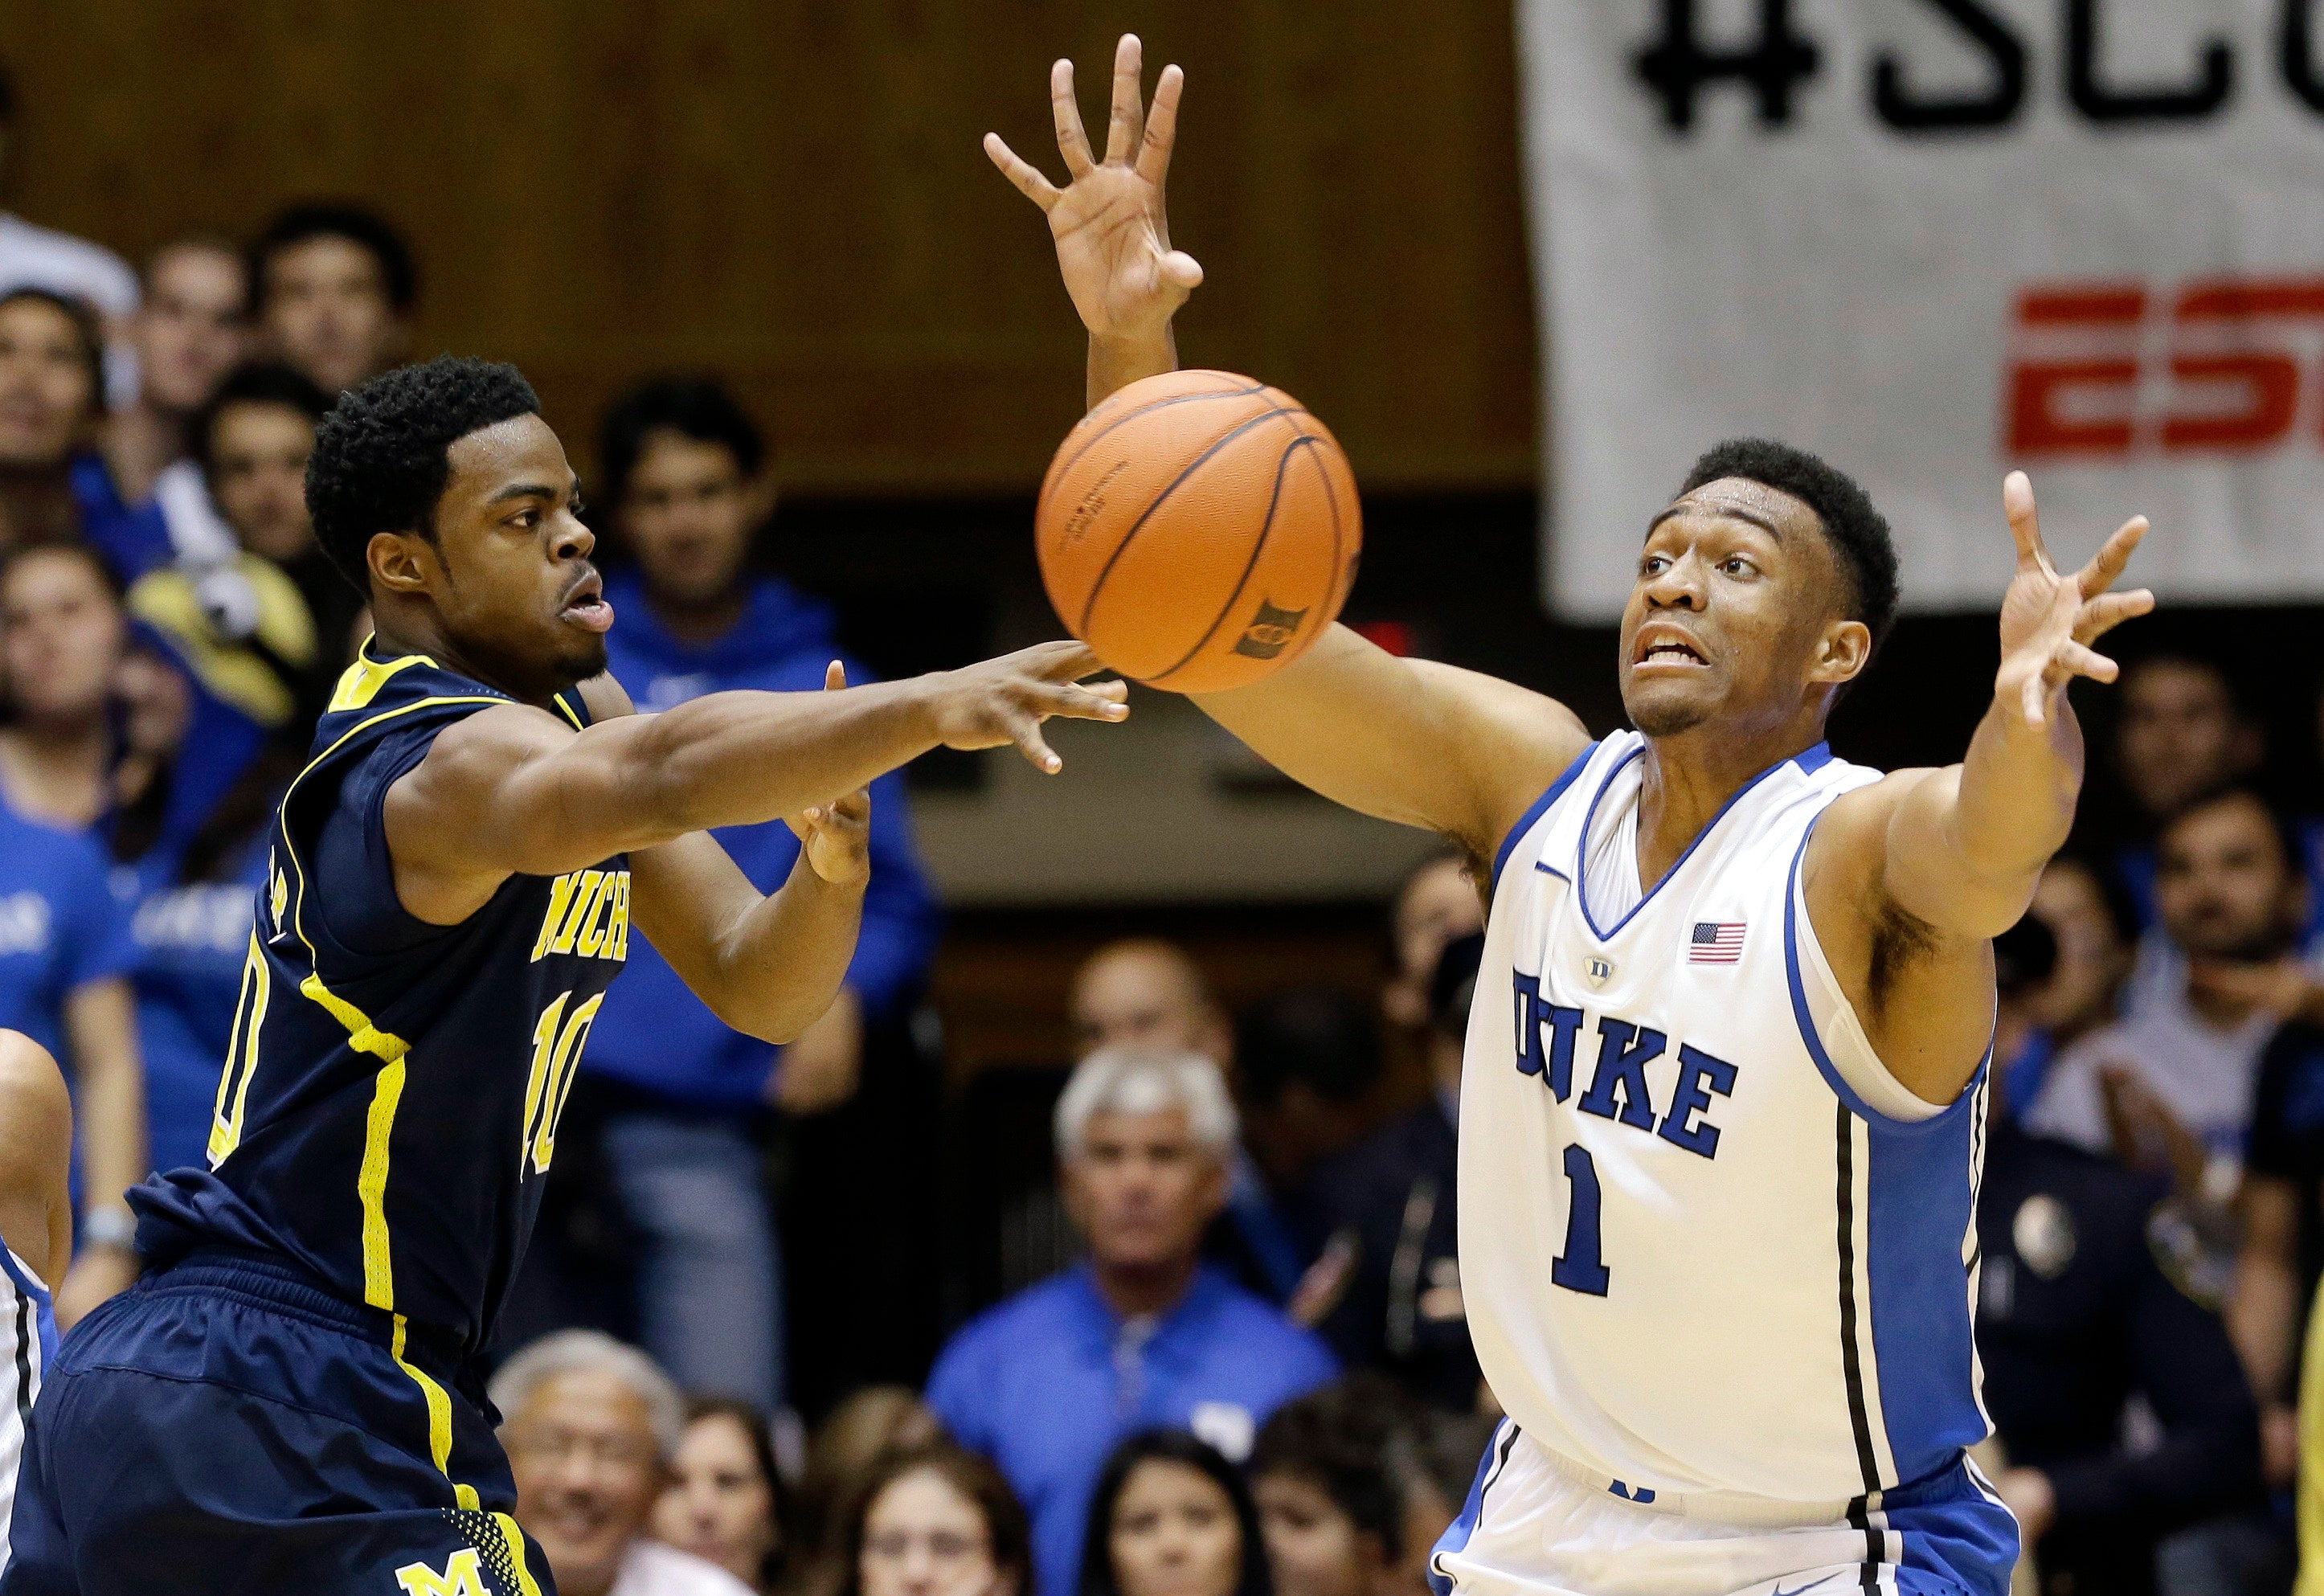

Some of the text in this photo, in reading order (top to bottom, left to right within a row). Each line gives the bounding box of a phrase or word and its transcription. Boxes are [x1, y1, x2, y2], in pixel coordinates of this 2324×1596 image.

[2004, 280, 2324, 458] ES
[530, 870, 631, 963] MICH
[519, 989, 607, 1183] 10
[1512, 972, 1739, 1160] DUKE
[1551, 1143, 1610, 1299] 1
[395, 1546, 493, 1596] M
